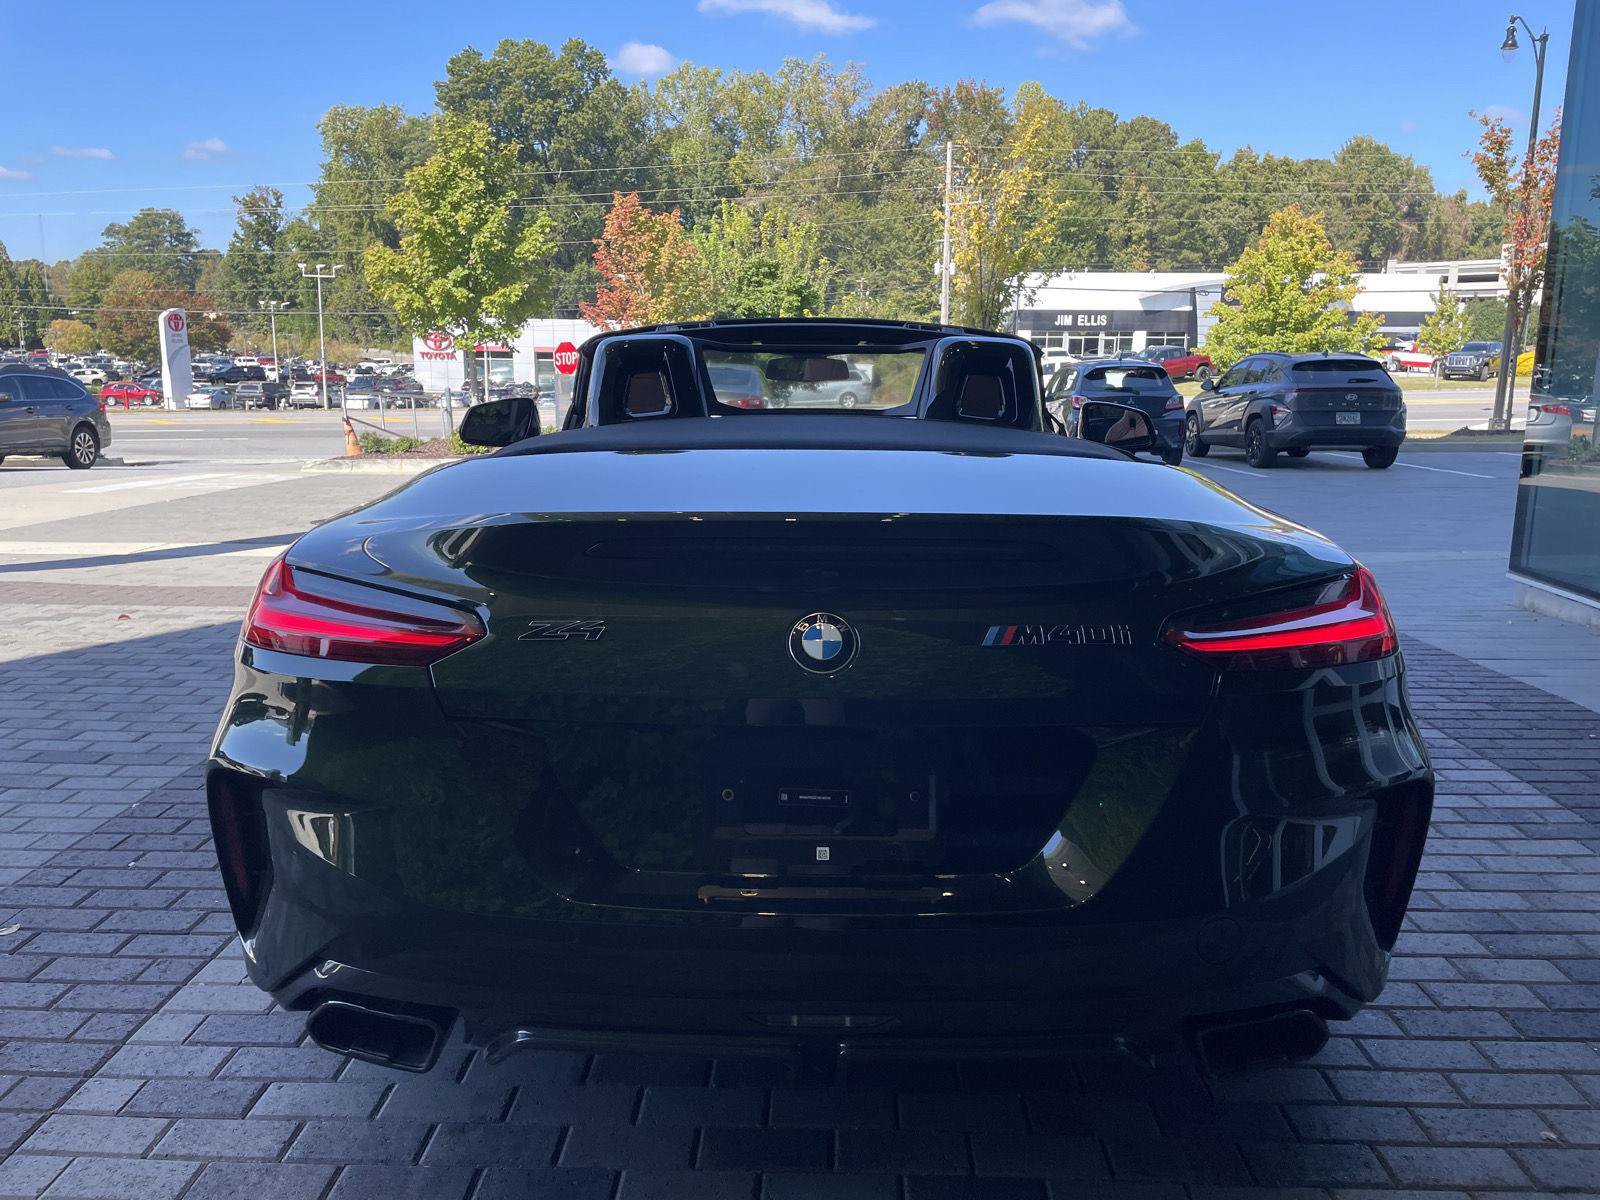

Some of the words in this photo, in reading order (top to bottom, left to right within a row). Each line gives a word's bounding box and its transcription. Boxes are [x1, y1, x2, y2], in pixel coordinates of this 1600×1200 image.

[1054, 314, 1073, 326] JIM
[1077, 314, 1108, 326] ELLIS
[419, 351, 458, 361] TOYOTA
[555, 352, 578, 366] STOP
[796, 614, 849, 632] BMW
[517, 620, 606, 641] Z4
